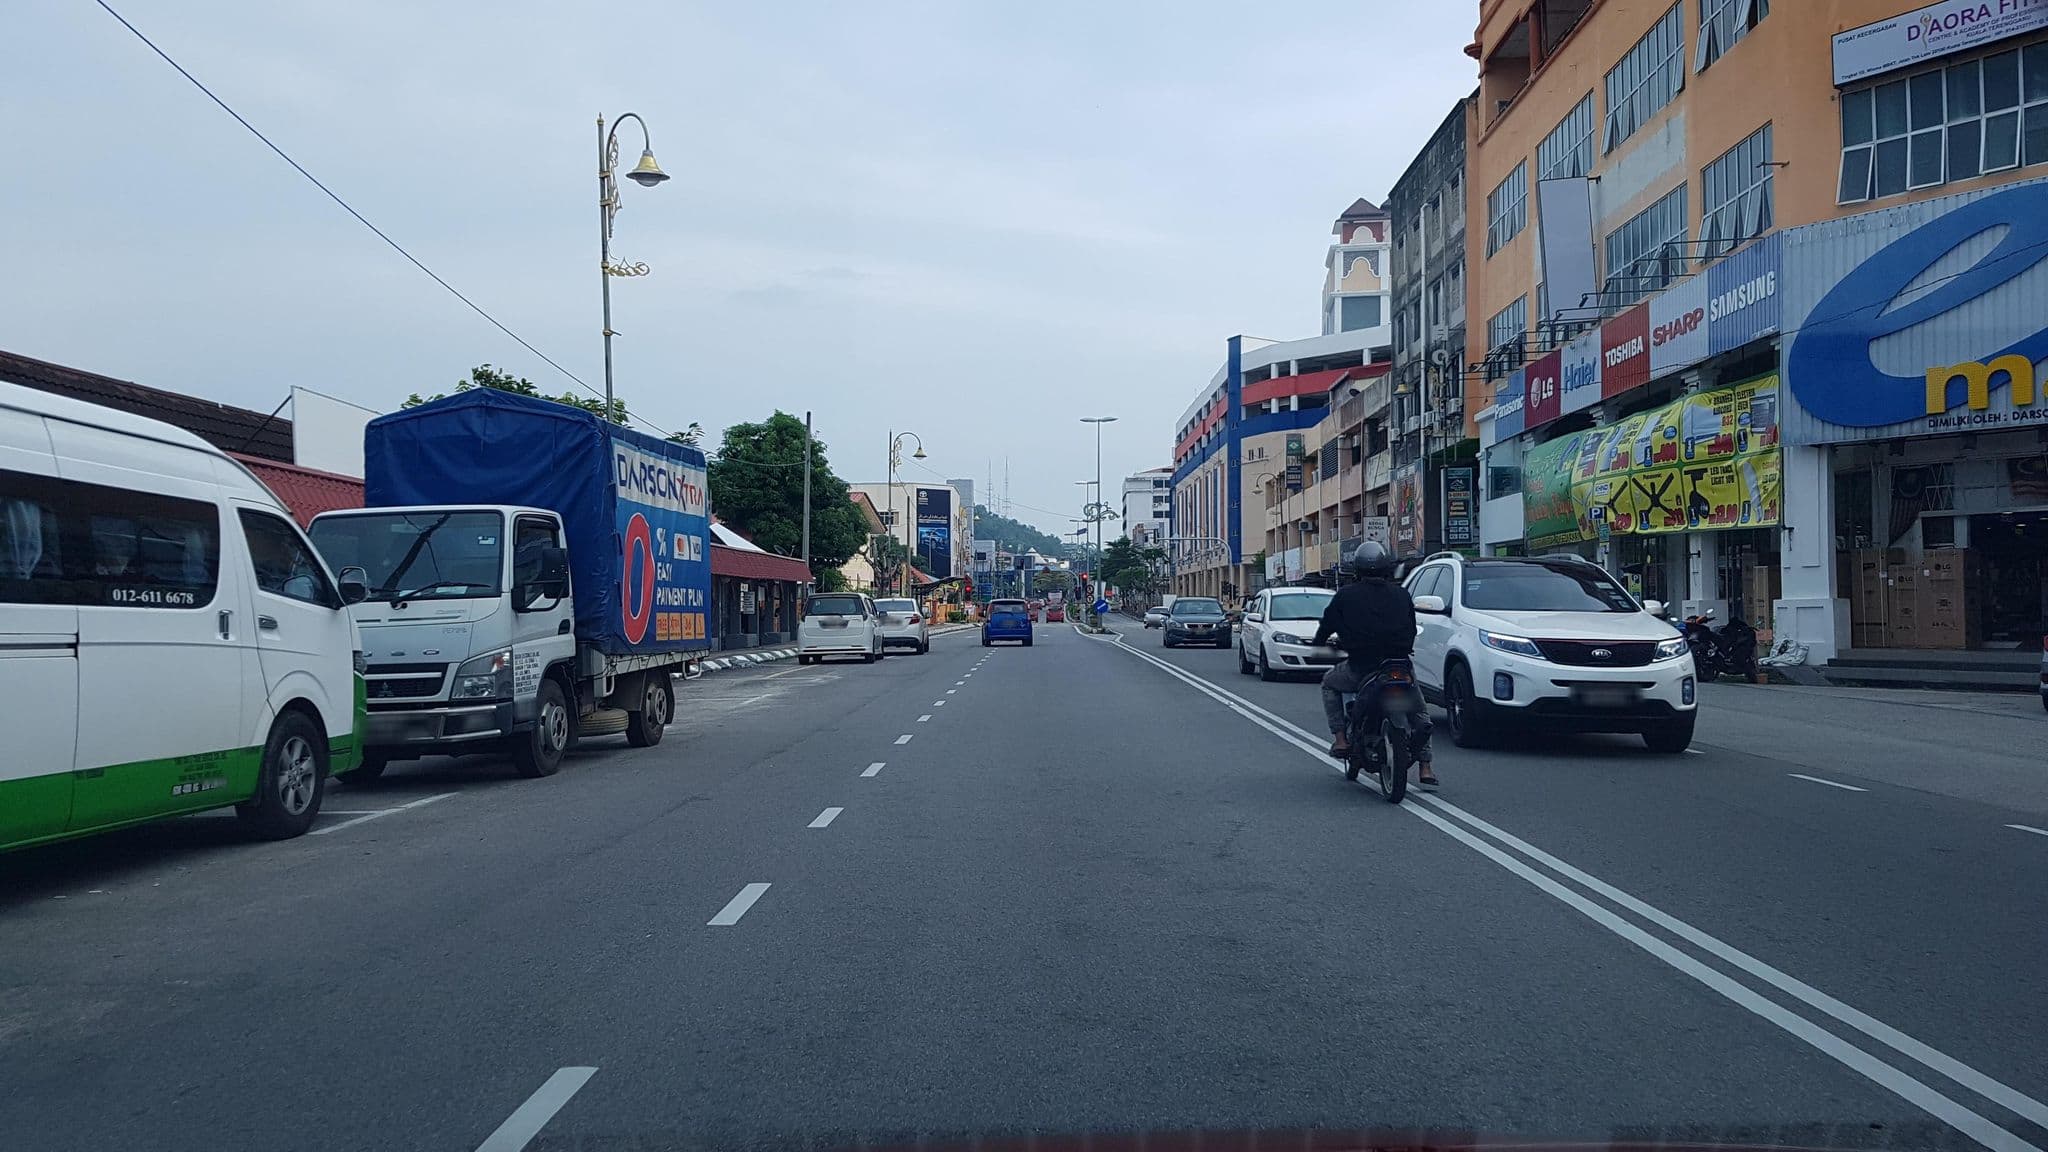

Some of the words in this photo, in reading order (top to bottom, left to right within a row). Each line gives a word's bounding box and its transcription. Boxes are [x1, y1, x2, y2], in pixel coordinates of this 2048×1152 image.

[1710, 270, 1776, 323] SAMSUNG
[1652, 307, 1704, 347] SHARP
[1605, 335, 1644, 369] TOSHIBA
[1563, 357, 1597, 394] Haier
[1542, 376, 1554, 400] LG
[1494, 395, 1525, 420] Panasonic
[1973, 413, 2001, 424] OLEH
[1710, 466, 1719, 475] LED
[1711, 475, 1724, 485] LIGHT
[656, 561, 673, 582] EASY
[112, 588, 162, 603] 012-611
[165, 591, 194, 604] 6678
[656, 584, 687, 607] PAYMENT
[687, 586, 704, 607] PLAN
